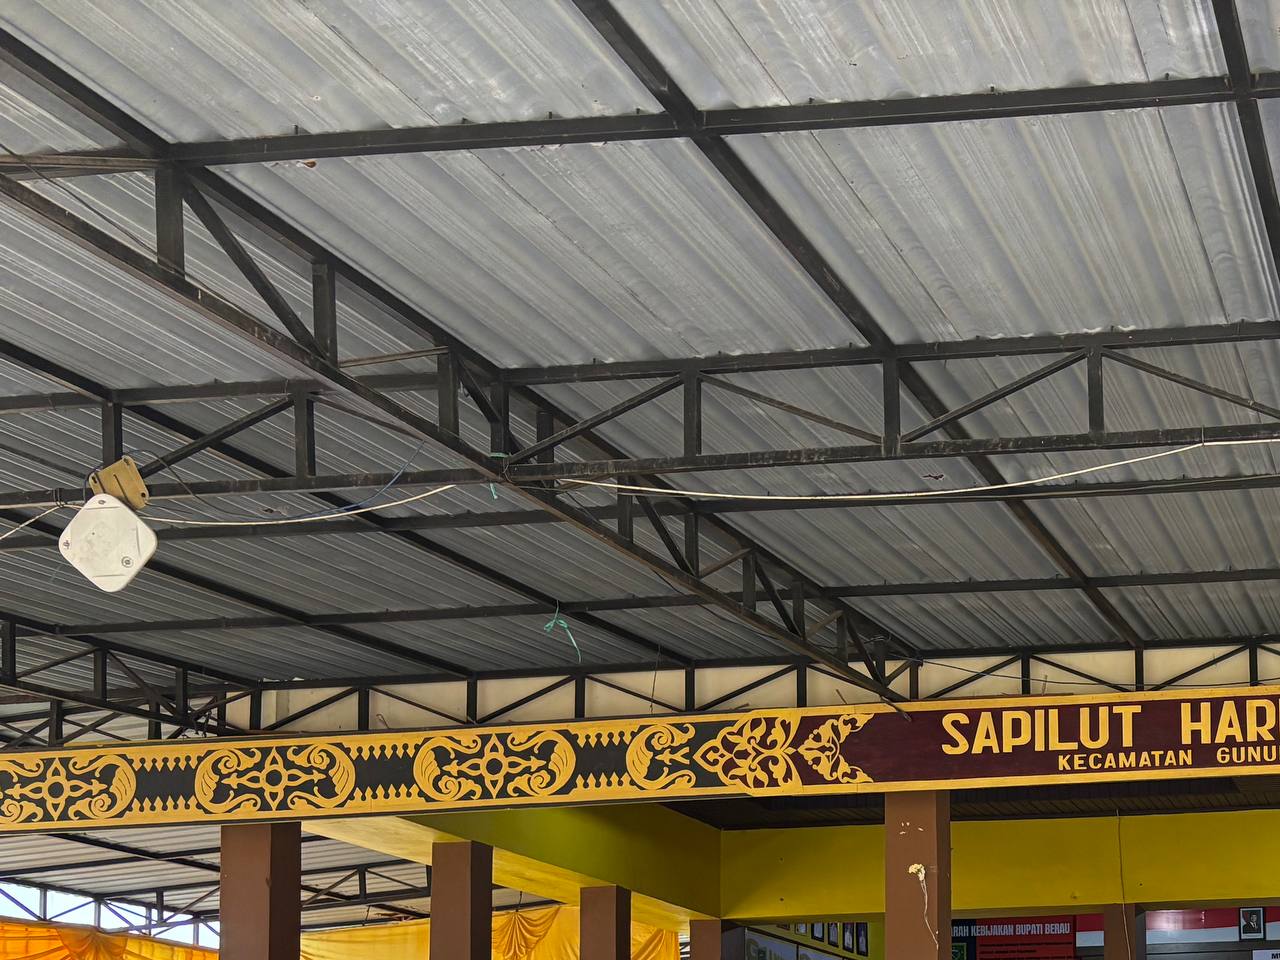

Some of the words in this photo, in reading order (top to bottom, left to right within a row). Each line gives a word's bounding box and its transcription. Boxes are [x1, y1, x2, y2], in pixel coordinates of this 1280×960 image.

[941, 705, 1142, 755] SAPILUT
[1058, 749, 1193, 771] KECAMATAN
[951, 925, 969, 937] RAH
[971, 924, 1014, 937] KEBIJAKAN
[1015, 923, 1043, 936] BUPATI
[1044, 922, 1071, 935] BERAU
